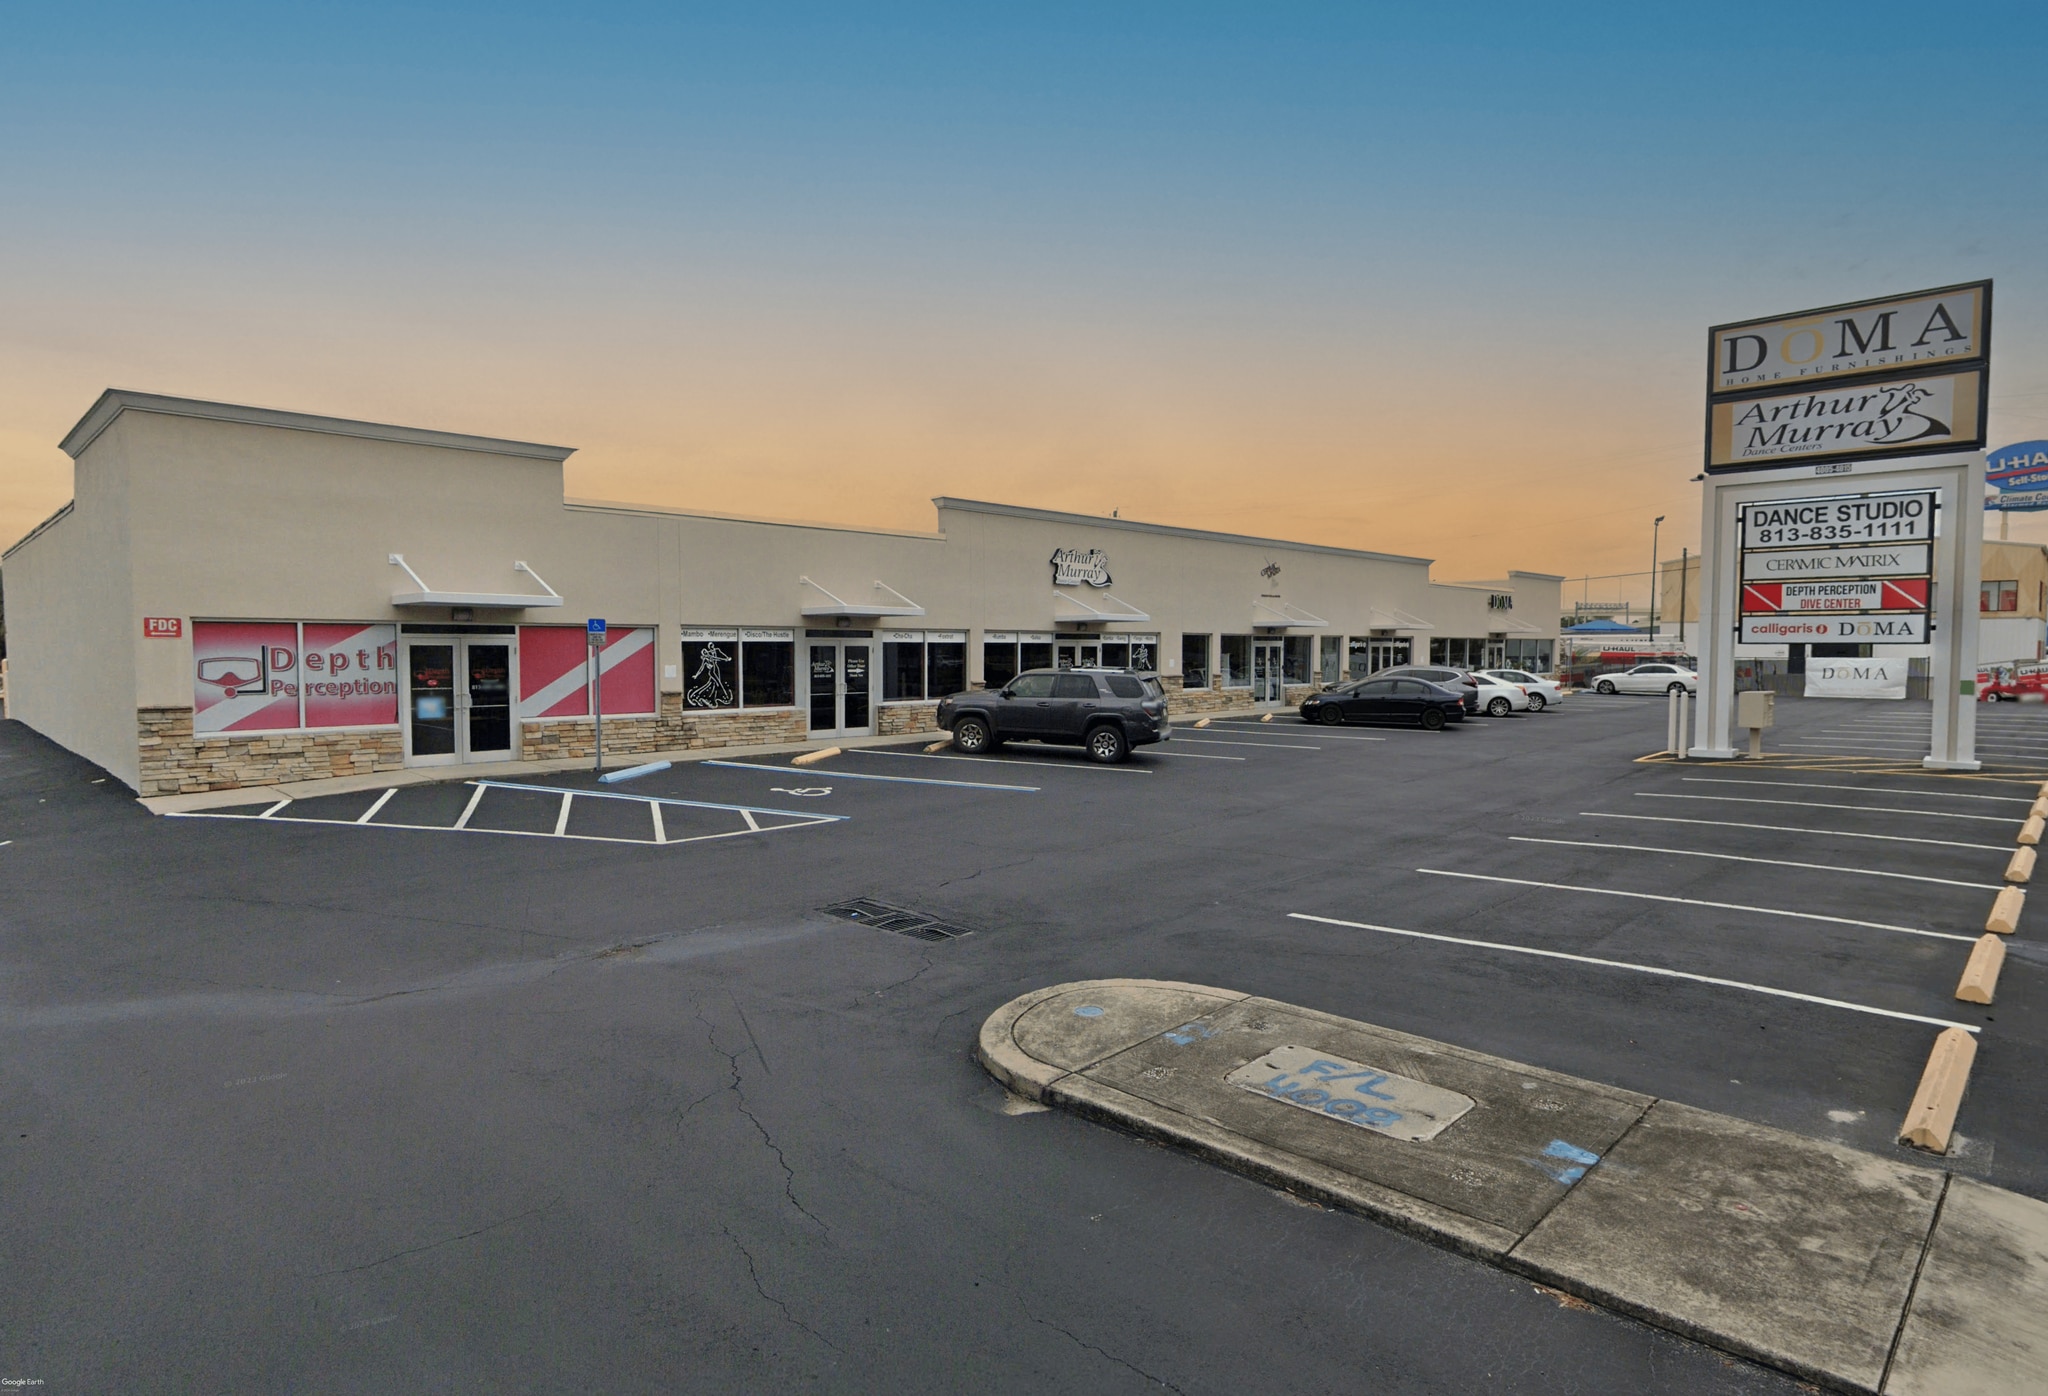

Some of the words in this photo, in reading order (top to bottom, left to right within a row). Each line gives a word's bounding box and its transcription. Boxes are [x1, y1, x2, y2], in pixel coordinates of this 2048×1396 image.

[1726, 372, 1781, 386] HOME
[1800, 345, 1972, 375] FURNISHINGS
[1734, 394, 1877, 426] Arthur
[1744, 417, 1904, 449] Murray
[1742, 448, 1776, 457] Dance
[1780, 443, 1823, 453] Centers
[2008, 474, 2048, 486] Self-Sto
[2000, 495, 2033, 503] Climate
[1754, 506, 1829, 527] DANCE
[1837, 500, 1923, 522] STUDIO
[1759, 520, 1915, 542] 813-835-1111
[1052, 549, 1093, 564] Arthur
[1766, 558, 1831, 571] CERAMIC
[1835, 554, 1900, 569] MATRIX
[1058, 564, 1101, 582] Murray
[1786, 585, 1816, 596] DEPTH
[1818, 584, 1876, 596] PERCEPTION
[1801, 599, 1821, 609] DIVE
[1824, 598, 1861, 608] CENTER
[149, 619, 178, 631] FDC
[1751, 623, 1813, 636] calligaris
[710, 631, 736, 639] Merengue
[270, 646, 394, 676] Depth
[270, 677, 396, 698] Perception
